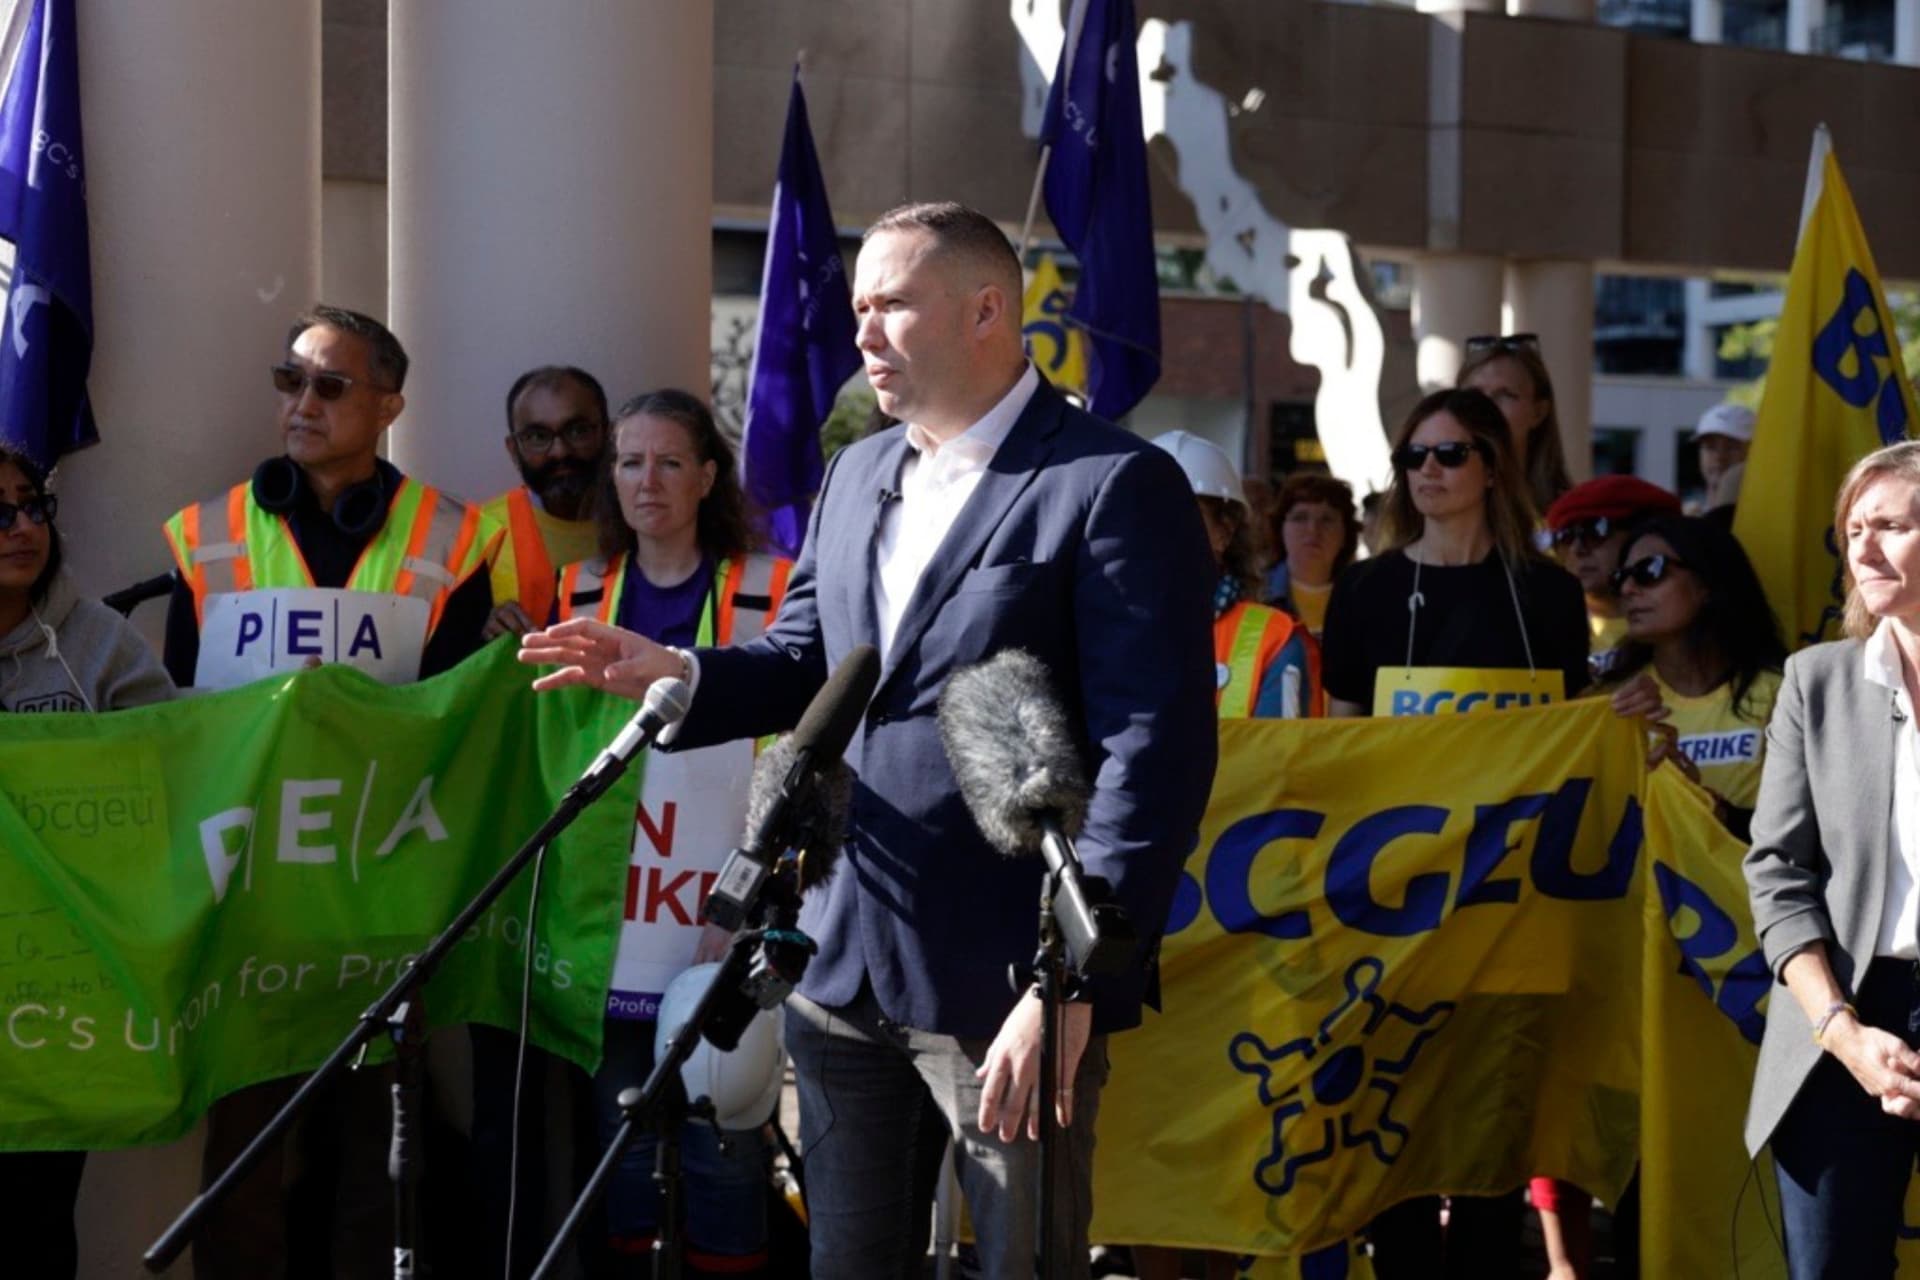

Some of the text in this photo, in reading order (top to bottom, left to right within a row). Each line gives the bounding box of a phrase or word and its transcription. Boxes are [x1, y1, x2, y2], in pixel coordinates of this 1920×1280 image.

[34, 130, 79, 179] BC's
[1676, 733, 1757, 764] TRIKE
[630, 801, 677, 858] N
[238, 956, 316, 997] for
[608, 998, 657, 1015] Profe
